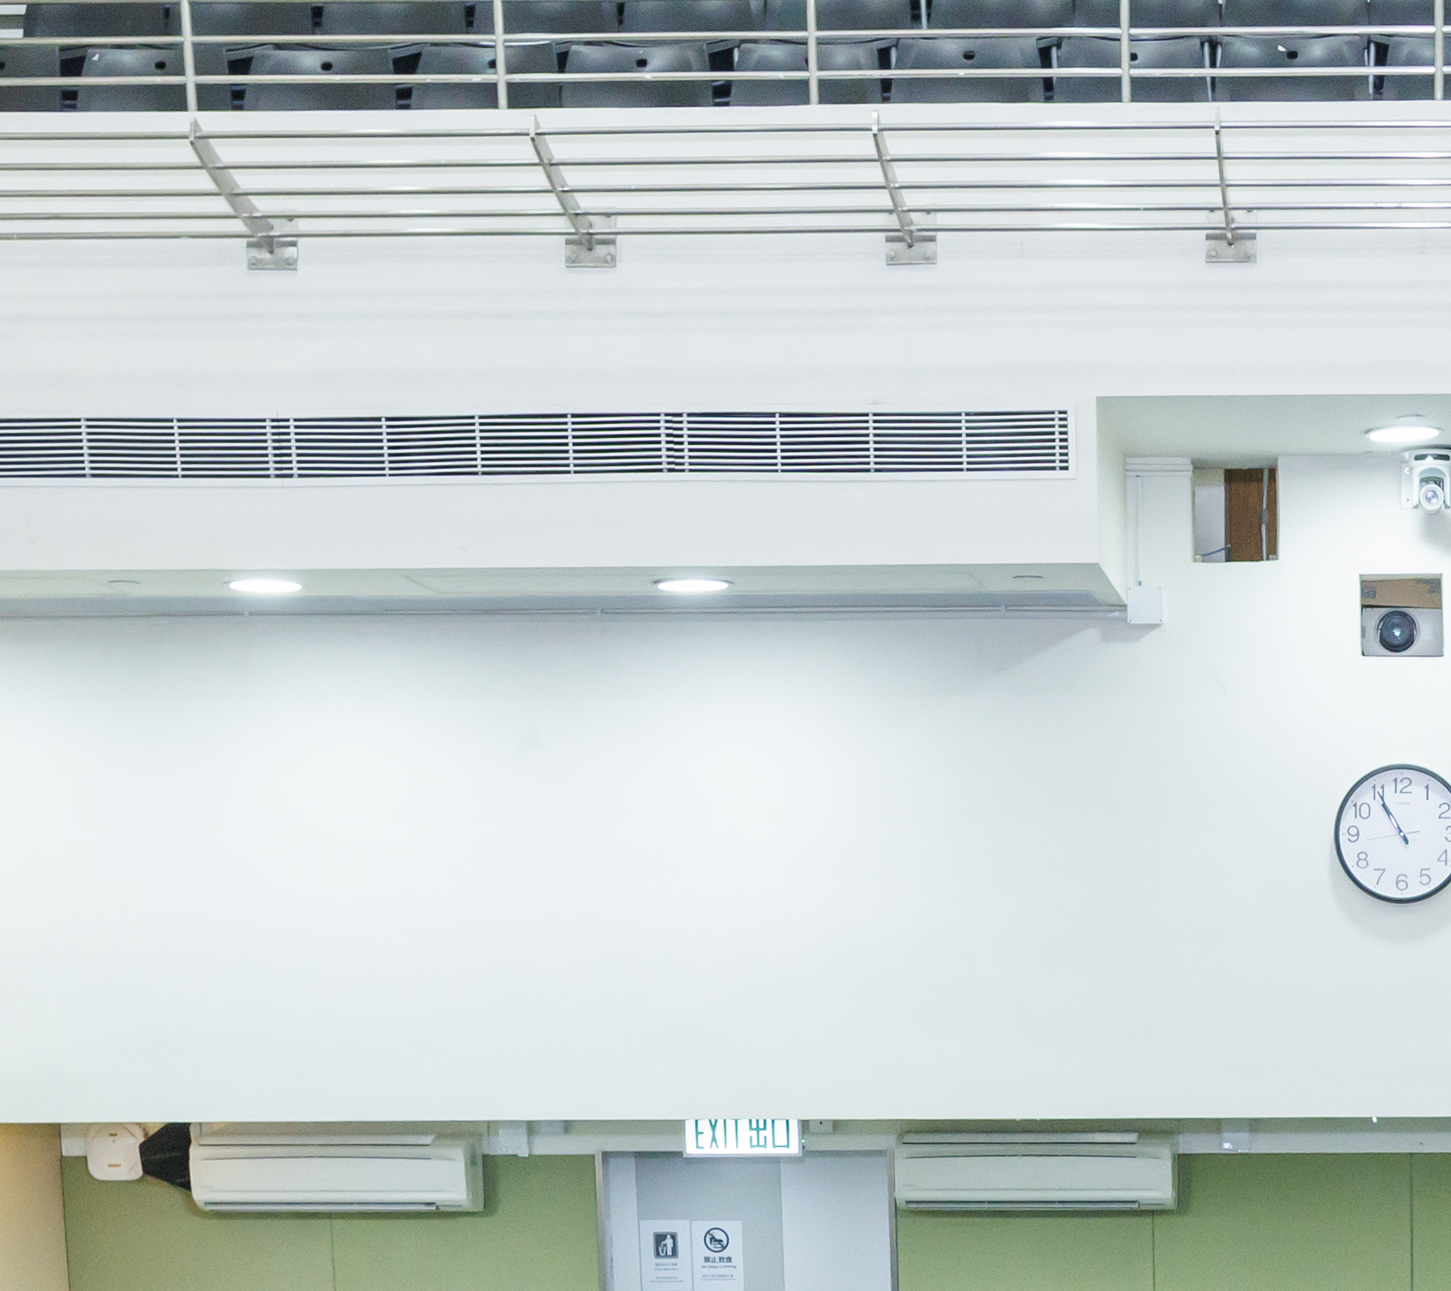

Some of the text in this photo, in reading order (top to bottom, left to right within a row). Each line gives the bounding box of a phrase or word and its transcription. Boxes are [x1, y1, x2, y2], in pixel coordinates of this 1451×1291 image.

[1371, 783, 1385, 801] 11
[1392, 777, 1413, 794] 12
[1424, 783, 1430, 801] 1
[1352, 802, 1371, 820] 10
[1437, 802, 1451, 820] 2
[1346, 825, 1360, 843] 9
[1355, 851, 1369, 869] 8
[1436, 849, 1450, 867] 4
[1373, 868, 1386, 886] 7
[1395, 873, 1409, 891] 6
[1418, 867, 1432, 886] 5
[694, 1118, 739, 1149] EXIT
[748, 1118, 790, 1149] 出口
